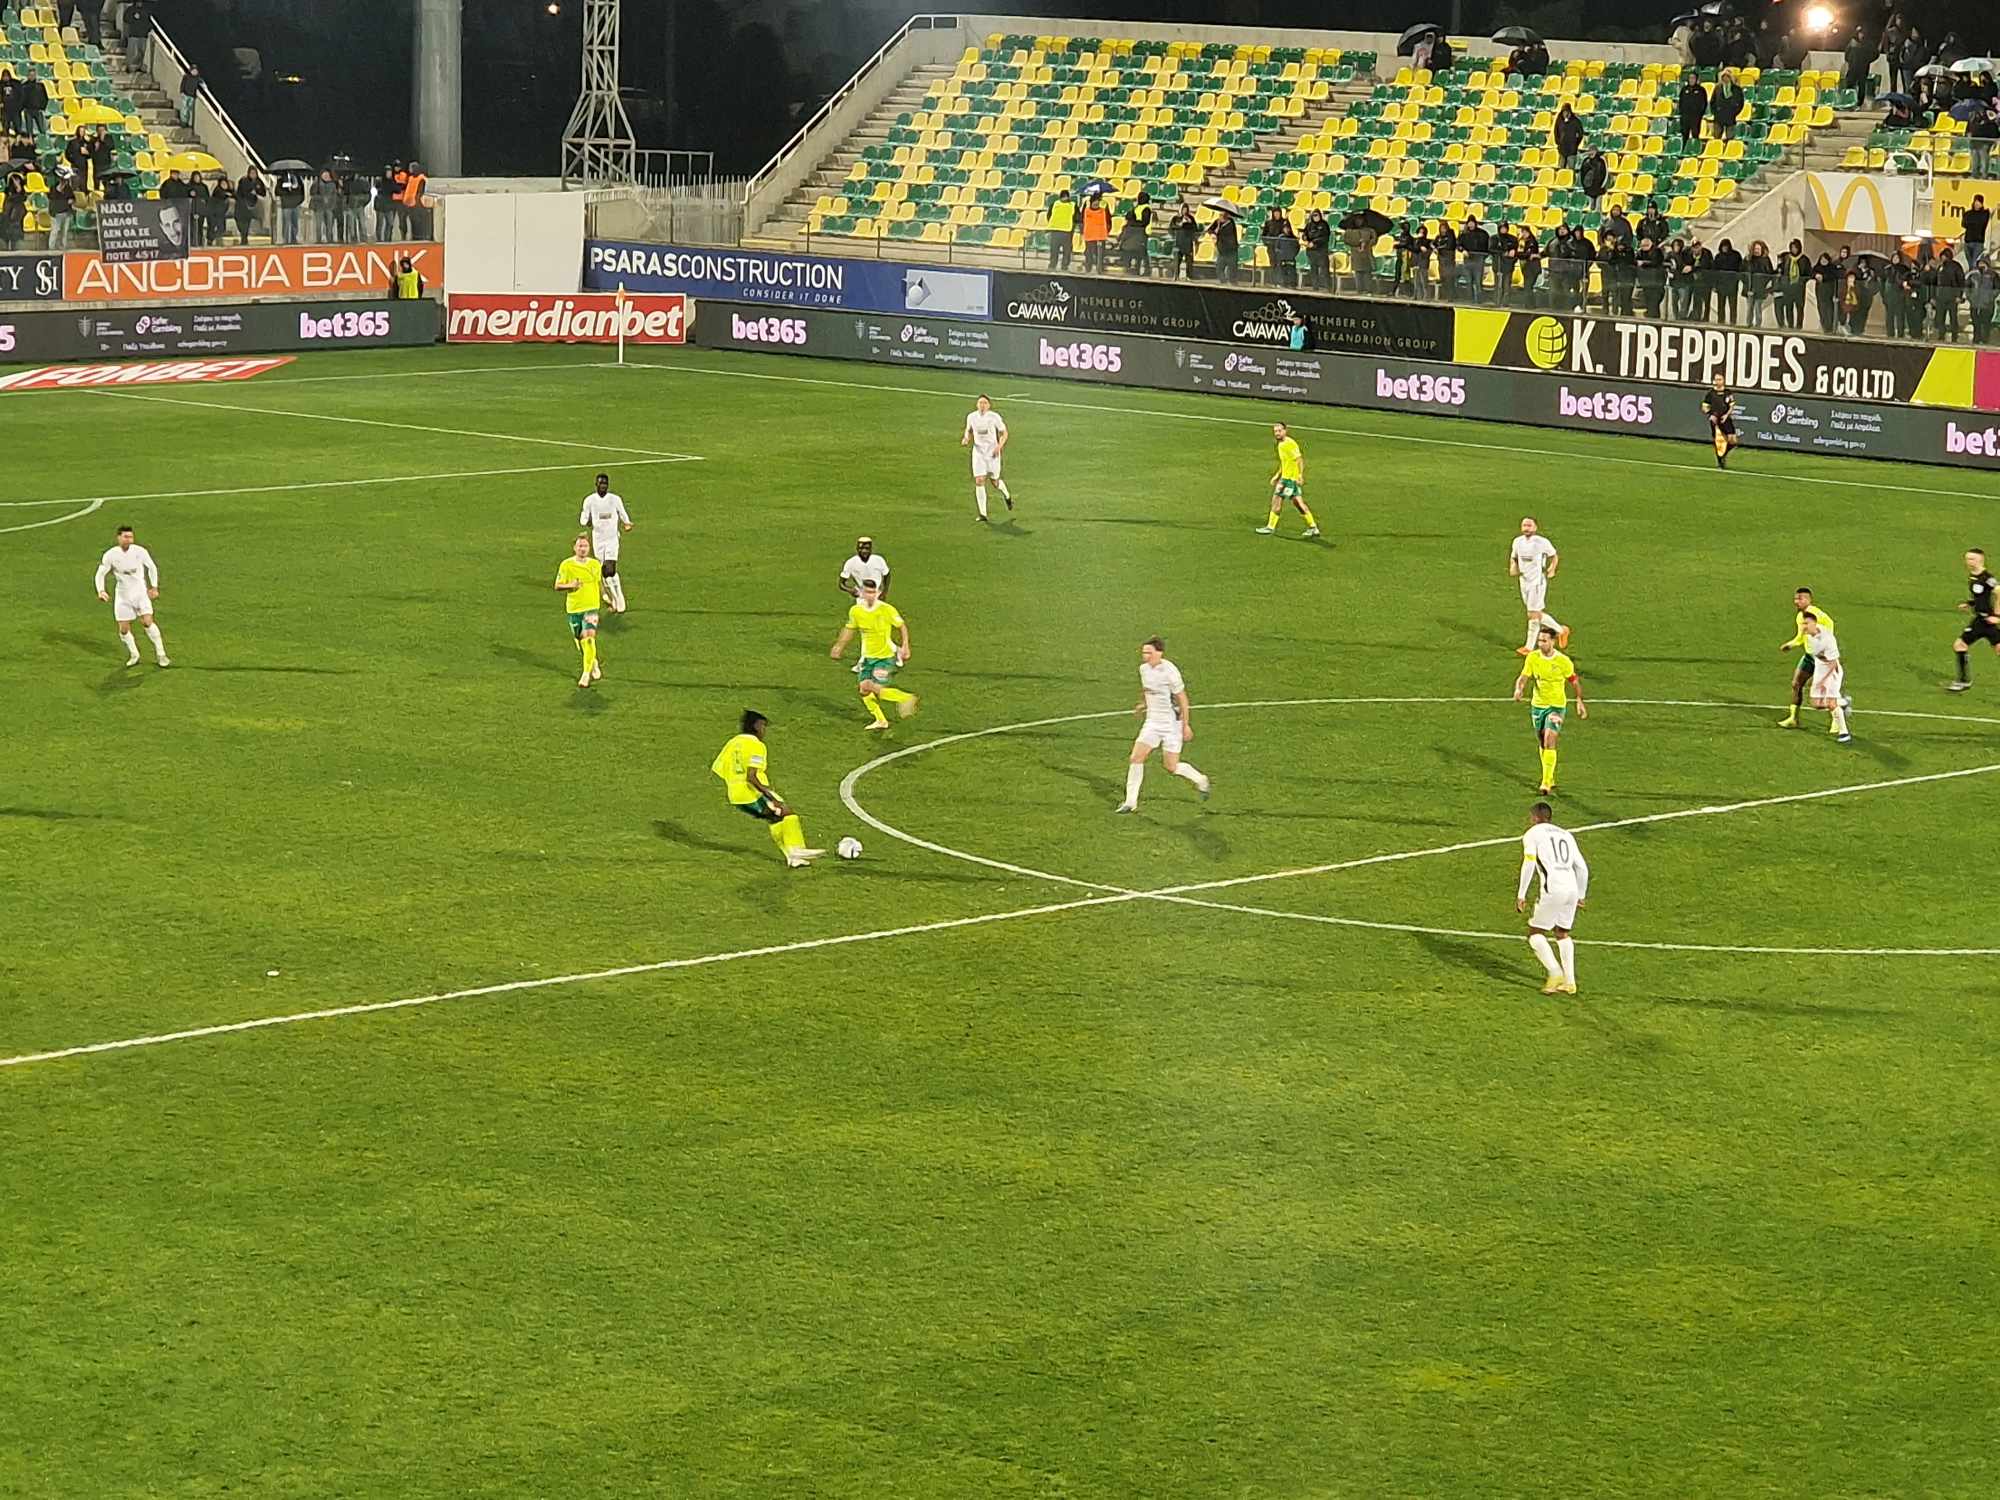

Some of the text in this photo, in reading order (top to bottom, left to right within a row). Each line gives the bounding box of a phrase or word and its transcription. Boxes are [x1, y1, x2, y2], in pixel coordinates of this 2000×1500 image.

[101, 203, 133, 214] ΝΑΣΟ
[104, 227, 150, 238] ΔΕΝ ΘΑ ΣΕ
[106, 251, 130, 260] ΠΟΤΕ
[77, 254, 291, 294] ANCORIA
[743, 287, 842, 304] CONSIDER IT DONE
[1080, 296, 1143, 309] MEMBER OF
[300, 311, 389, 339] bet365
[449, 300, 683, 337] meridianbet
[1007, 302, 1067, 322] CAVAWAY
[1079, 311, 1200, 329] ALEXANDRION GROUP
[1310, 315, 1376, 329] MEMBER OF
[732, 313, 807, 344] bet365
[1233, 320, 1291, 341] CAVAWA
[1317, 331, 1437, 350] LEXANDRION GROUP
[1039, 338, 1122, 372] bet365
[1571, 319, 1604, 374] K.
[1615, 322, 1805, 392] TREPPIDES
[1815, 365, 1829, 394] &
[1862, 369, 1895, 399] LTD
[16, 359, 280, 387] FONBET
[1376, 369, 1465, 405] bet365
[1559, 386, 1653, 424] bet365
[1946, 422, 2000, 457] bet
[1550, 837, 1570, 864] 10
